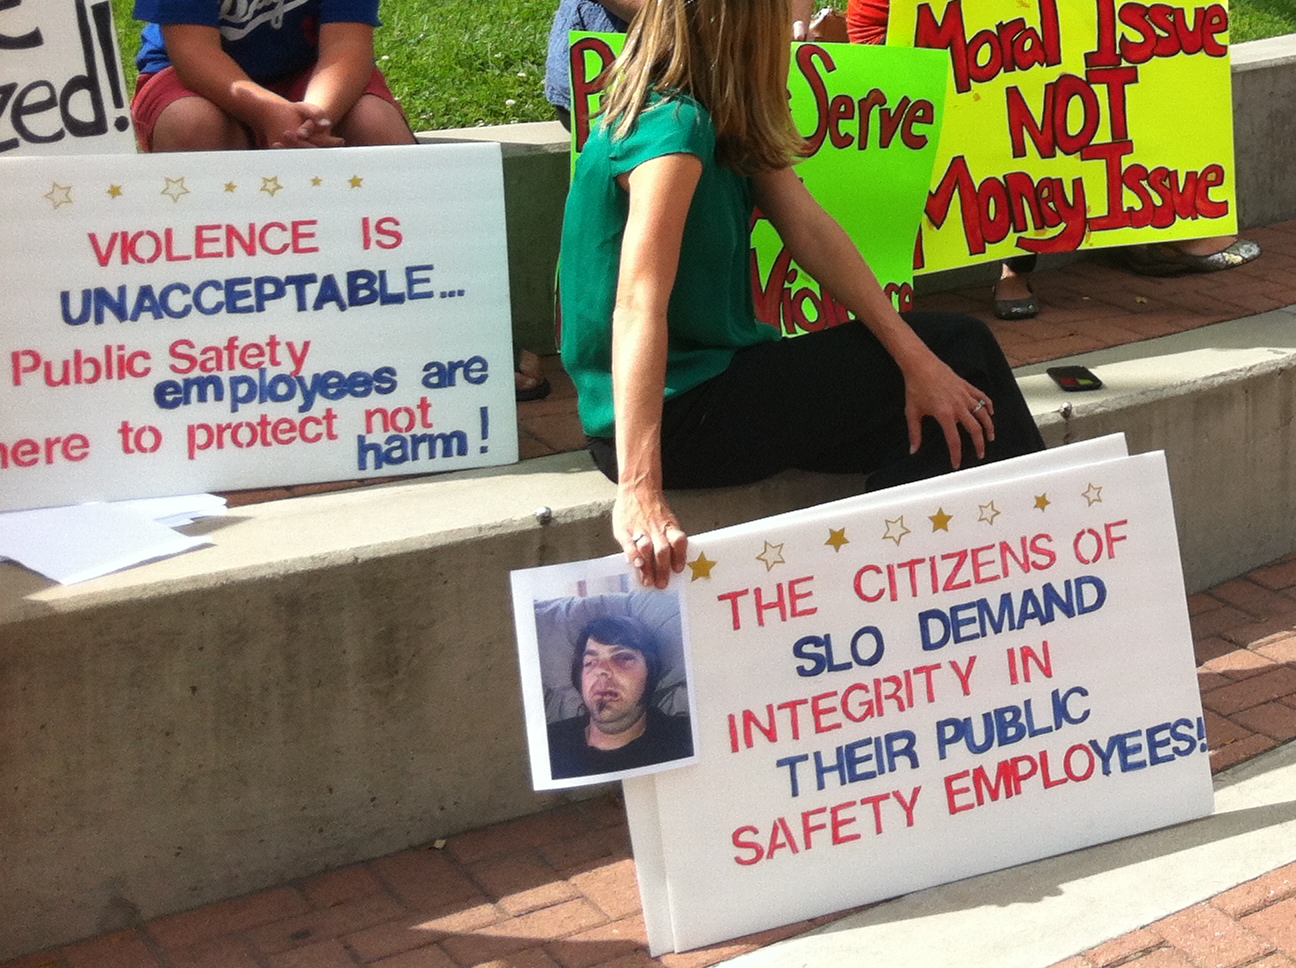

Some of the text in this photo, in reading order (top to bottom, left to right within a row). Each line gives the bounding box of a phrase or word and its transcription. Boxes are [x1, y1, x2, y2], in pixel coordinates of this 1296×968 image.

[793, 44, 935, 158] Serve
[1006, 65, 1139, 159] NOT
[88, 216, 404, 267] VIOLENCE IS
[913, 139, 1229, 270] Money Issue
[60, 264, 466, 326] UNACCEPTABLE...
[11, 335, 311, 388] Public Safety
[153, 355, 489, 414] employees are
[118, 421, 163, 454] to
[186, 407, 339, 460] protect
[365, 396, 433, 434] not
[717, 519, 1129, 632] THE CITIZENS OF
[792, 574, 1108, 677] SLO DEMAND
[727, 640, 1053, 753] INTEGRITY IN
[776, 685, 1091, 798] THEIR PUBLIC
[731, 716, 1209, 867] SAFETY EMPLOYEES!
